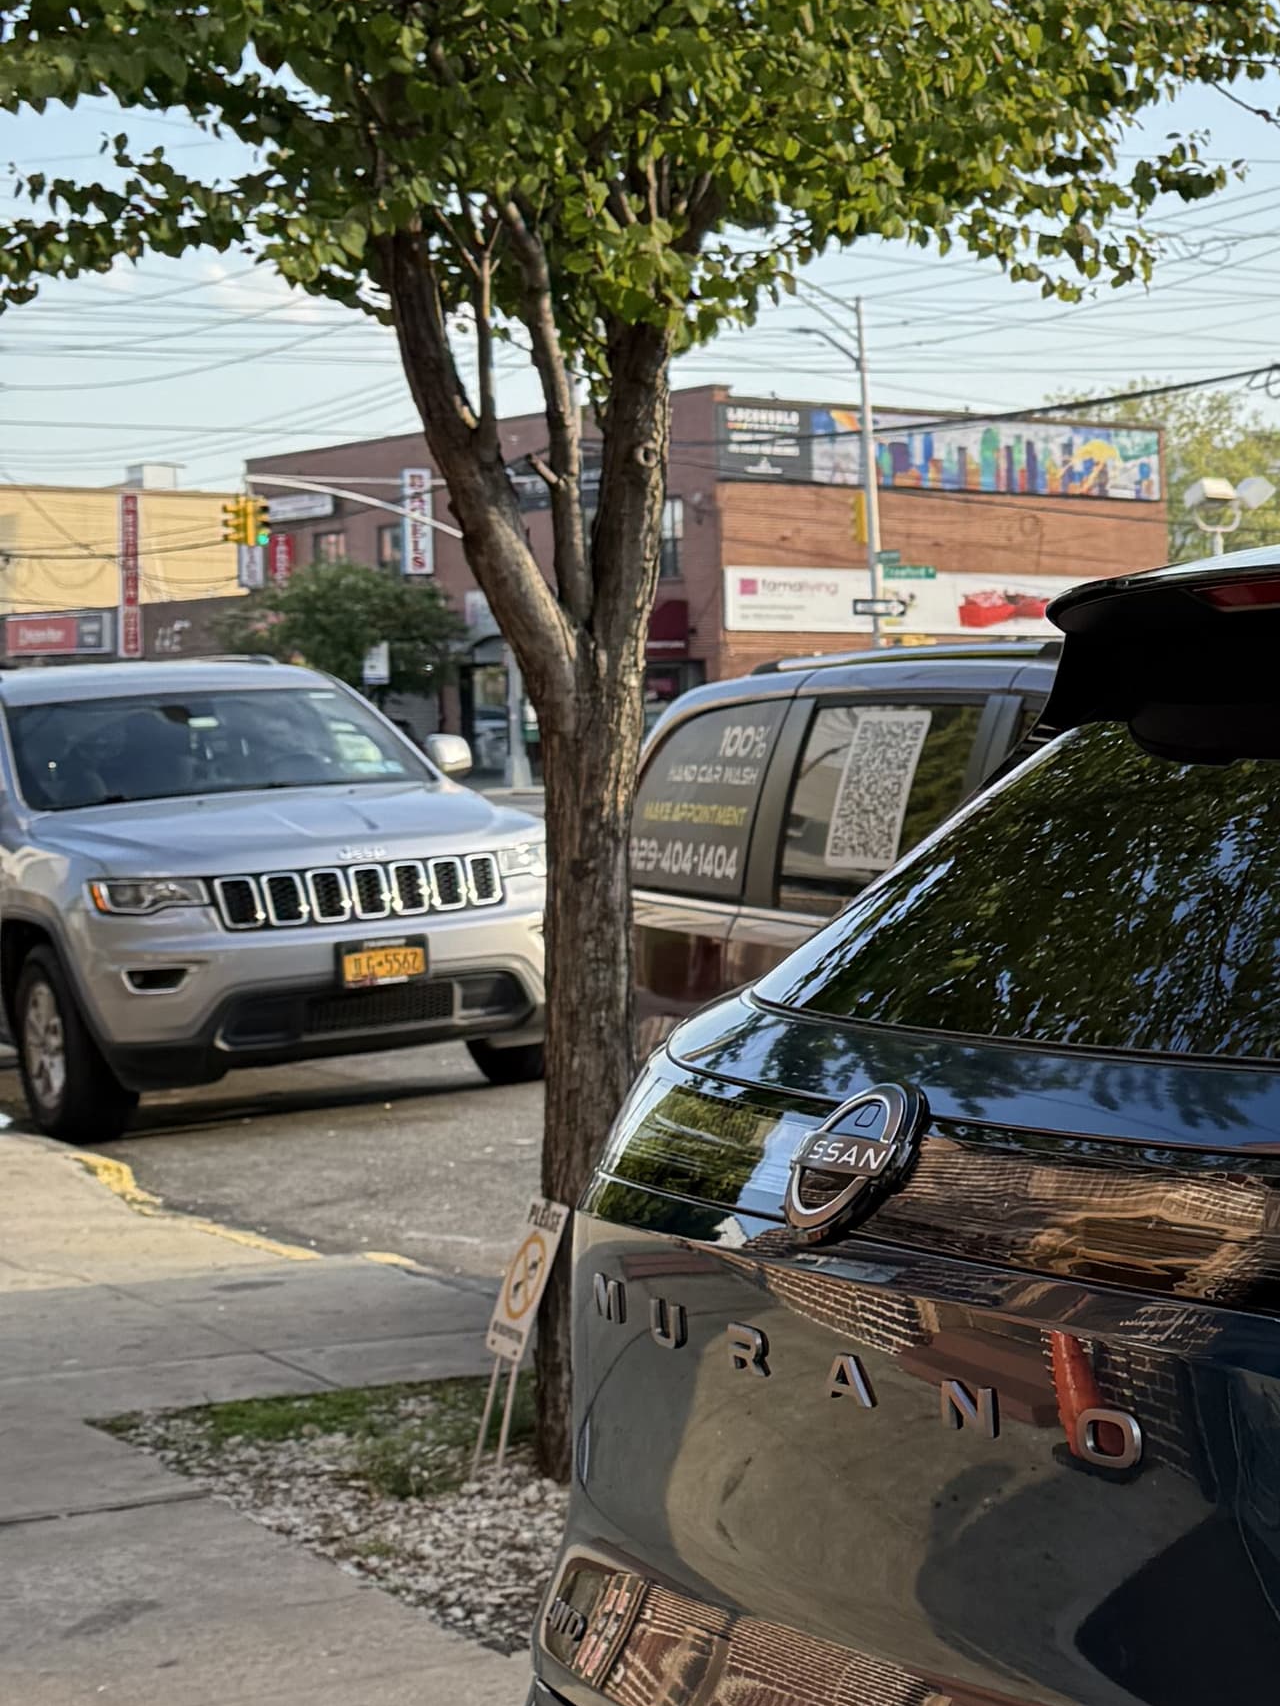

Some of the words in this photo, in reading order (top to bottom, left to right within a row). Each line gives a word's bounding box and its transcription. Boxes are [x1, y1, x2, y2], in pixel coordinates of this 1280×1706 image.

[408, 474, 427, 570] BAELS
[719, 724, 771, 759] 100%
[697, 765, 722, 784] CAR
[722, 766, 760, 786] WASH
[528, 1202, 563, 1235] PLEASE
[593, 1271, 1144, 1471] MURANO
